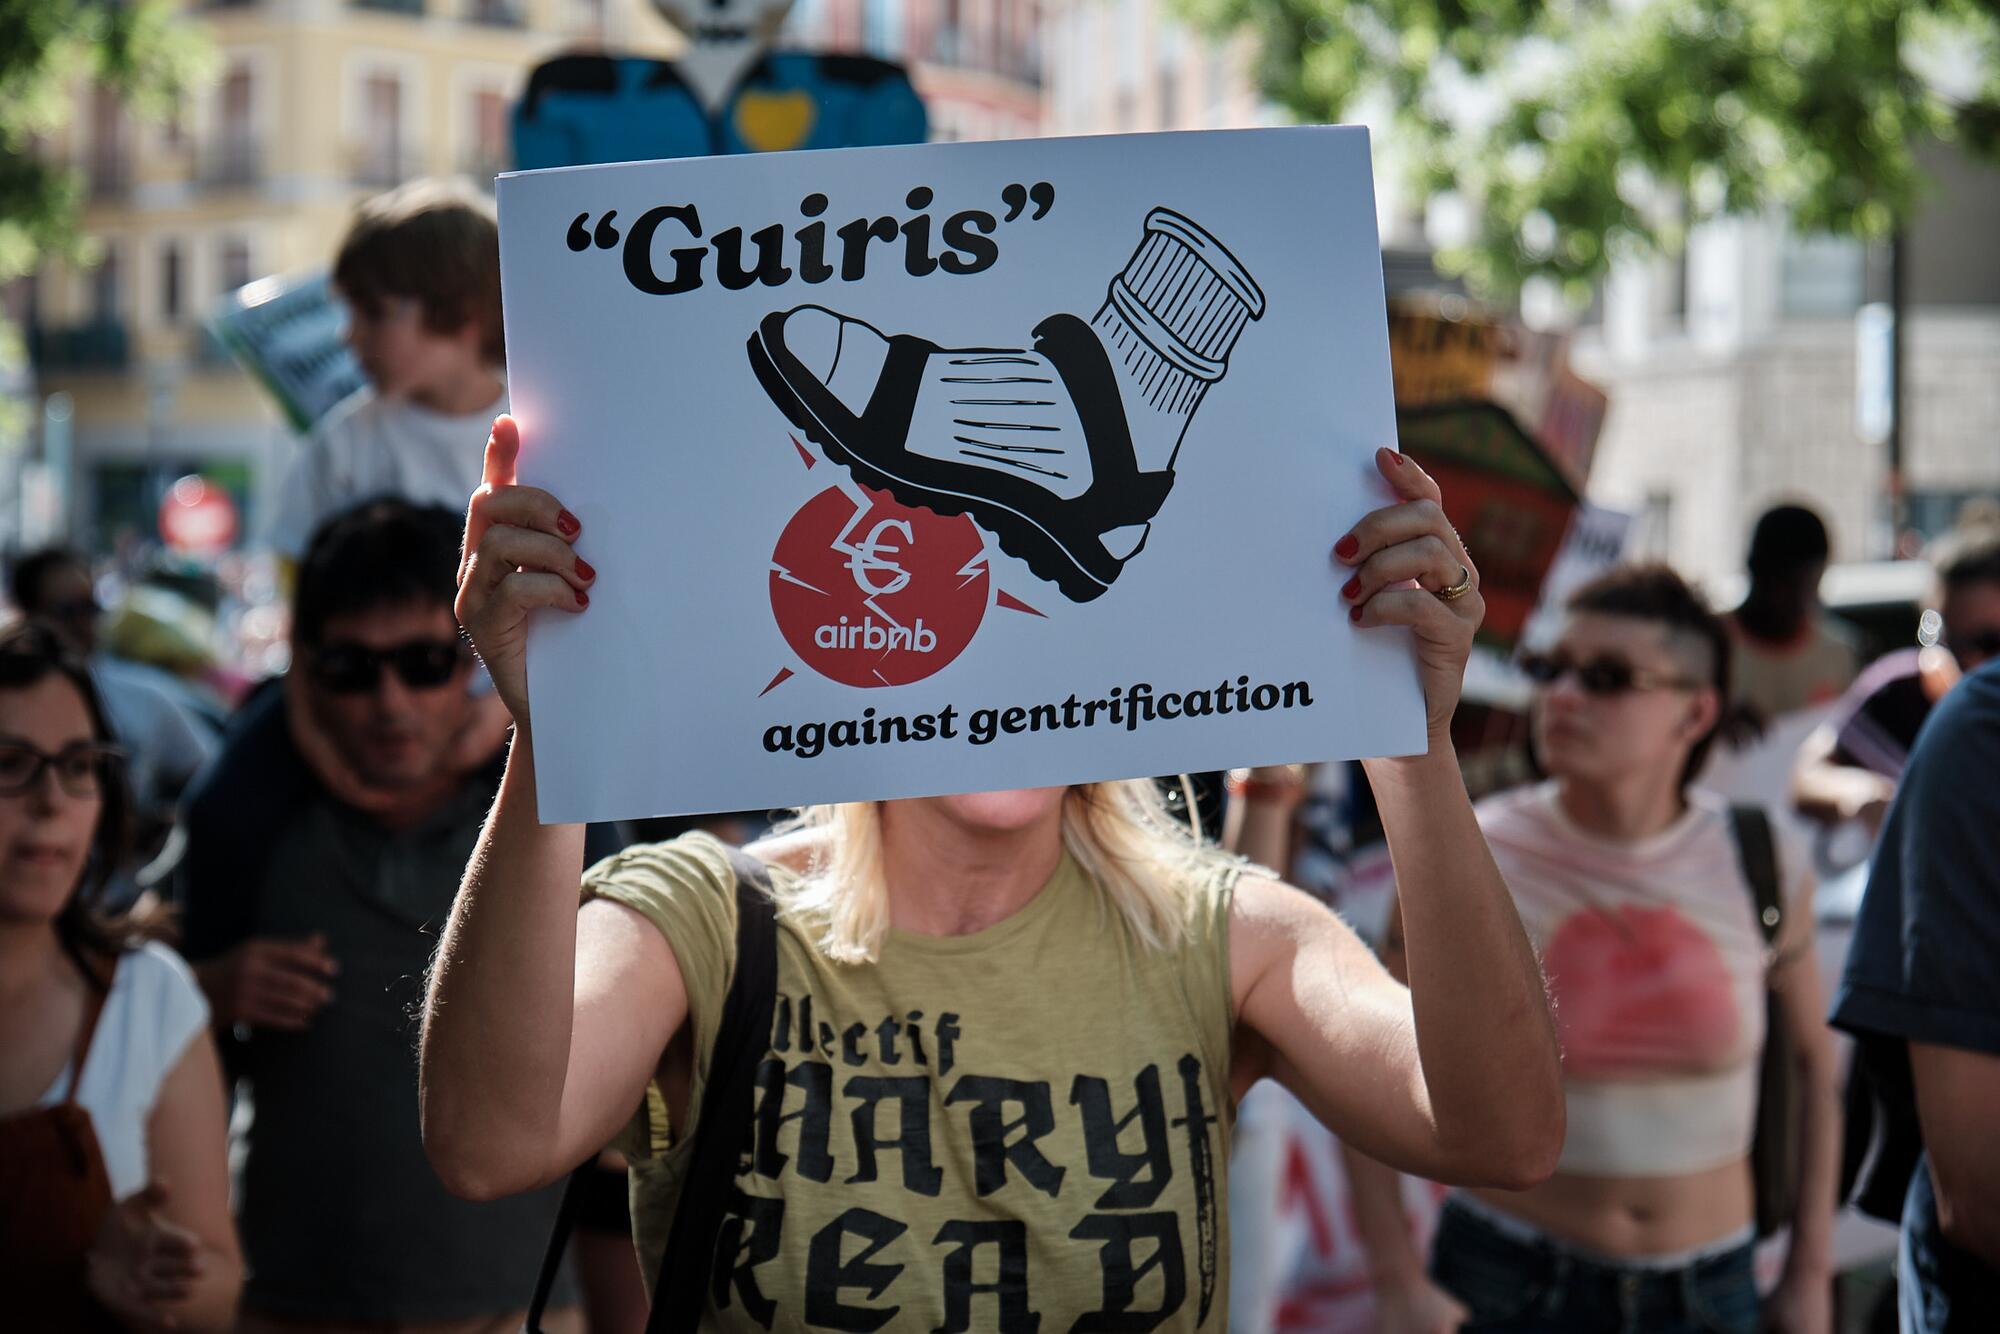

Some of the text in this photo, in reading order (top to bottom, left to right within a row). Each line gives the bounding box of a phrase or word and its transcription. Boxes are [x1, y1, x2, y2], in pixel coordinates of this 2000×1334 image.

[566, 181, 1056, 296] “Guiris”
[814, 616, 938, 653] airbnb
[762, 675, 1313, 758] against gentrification
[771, 993, 962, 1077] llectif
